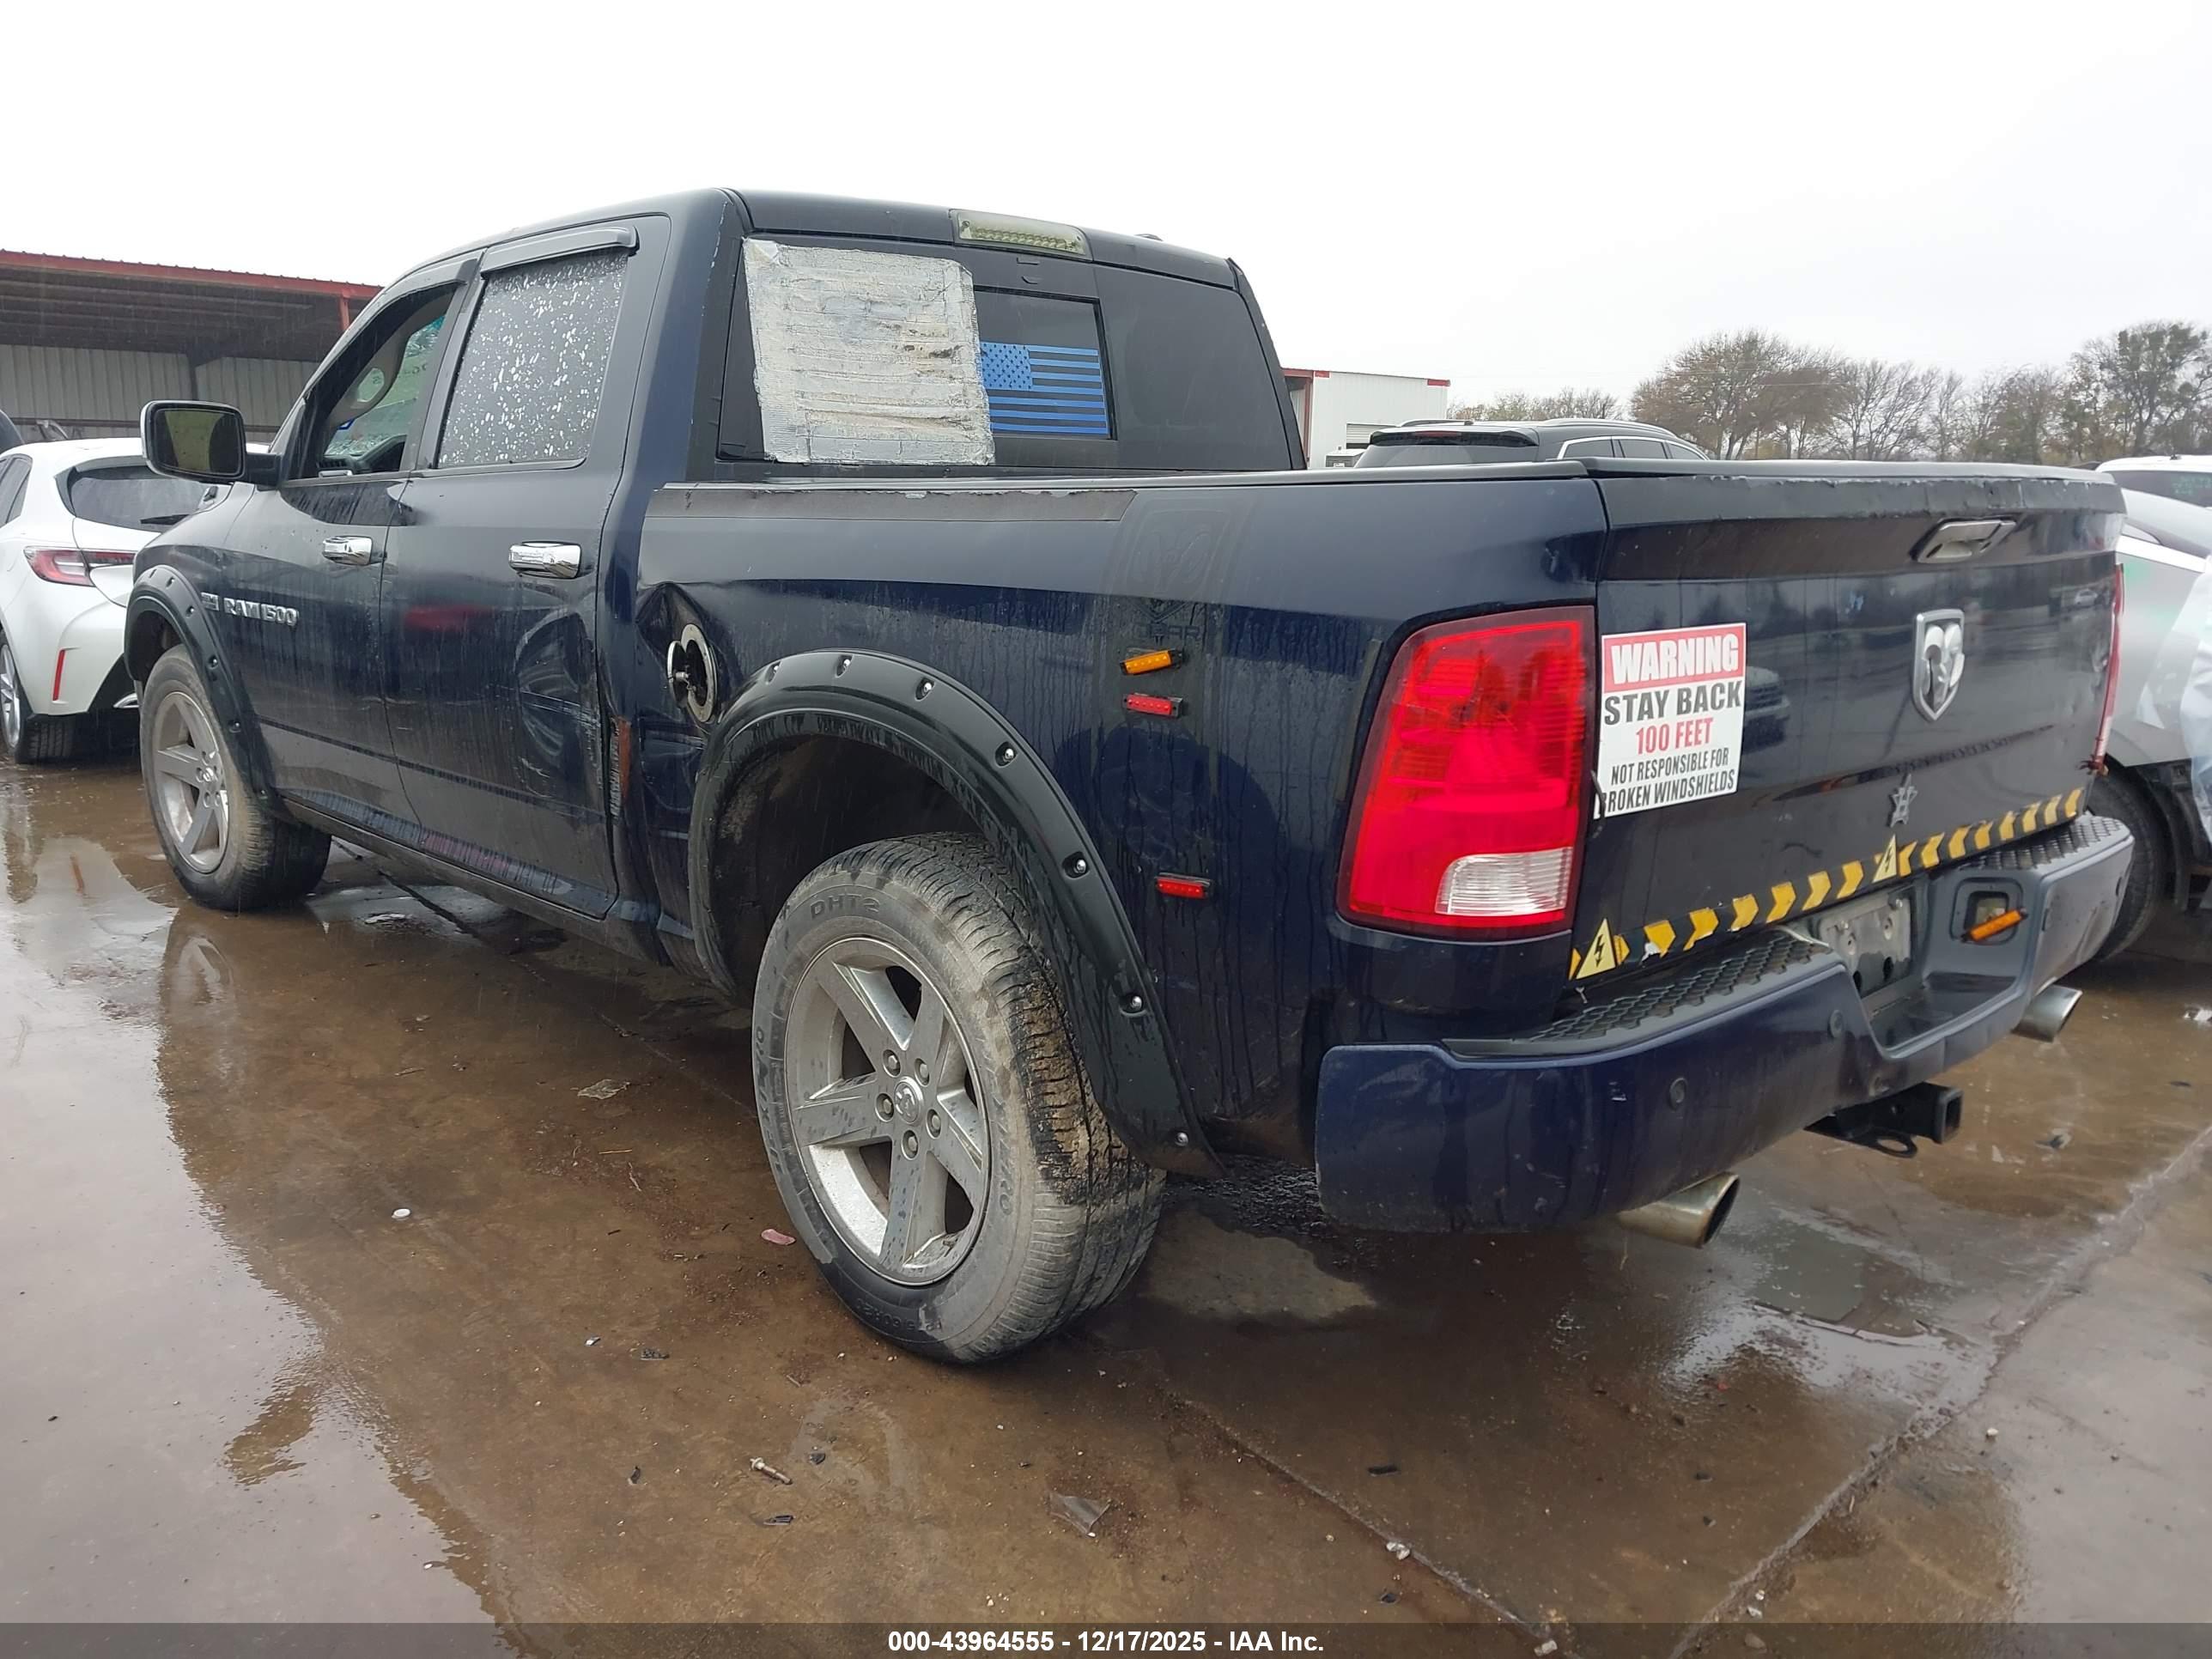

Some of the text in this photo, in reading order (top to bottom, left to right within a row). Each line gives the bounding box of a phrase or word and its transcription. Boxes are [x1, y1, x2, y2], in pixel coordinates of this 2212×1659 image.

[260, 604, 298, 625] 1500
[1611, 634, 1739, 684] WARNING
[1604, 680, 1743, 726] STAY BACK
[1636, 718, 1714, 755] 100 FEET
[1611, 747, 1729, 786] NOT RESPONSIBLE FOR
[1654, 769, 1735, 804] WINDSHIELDS
